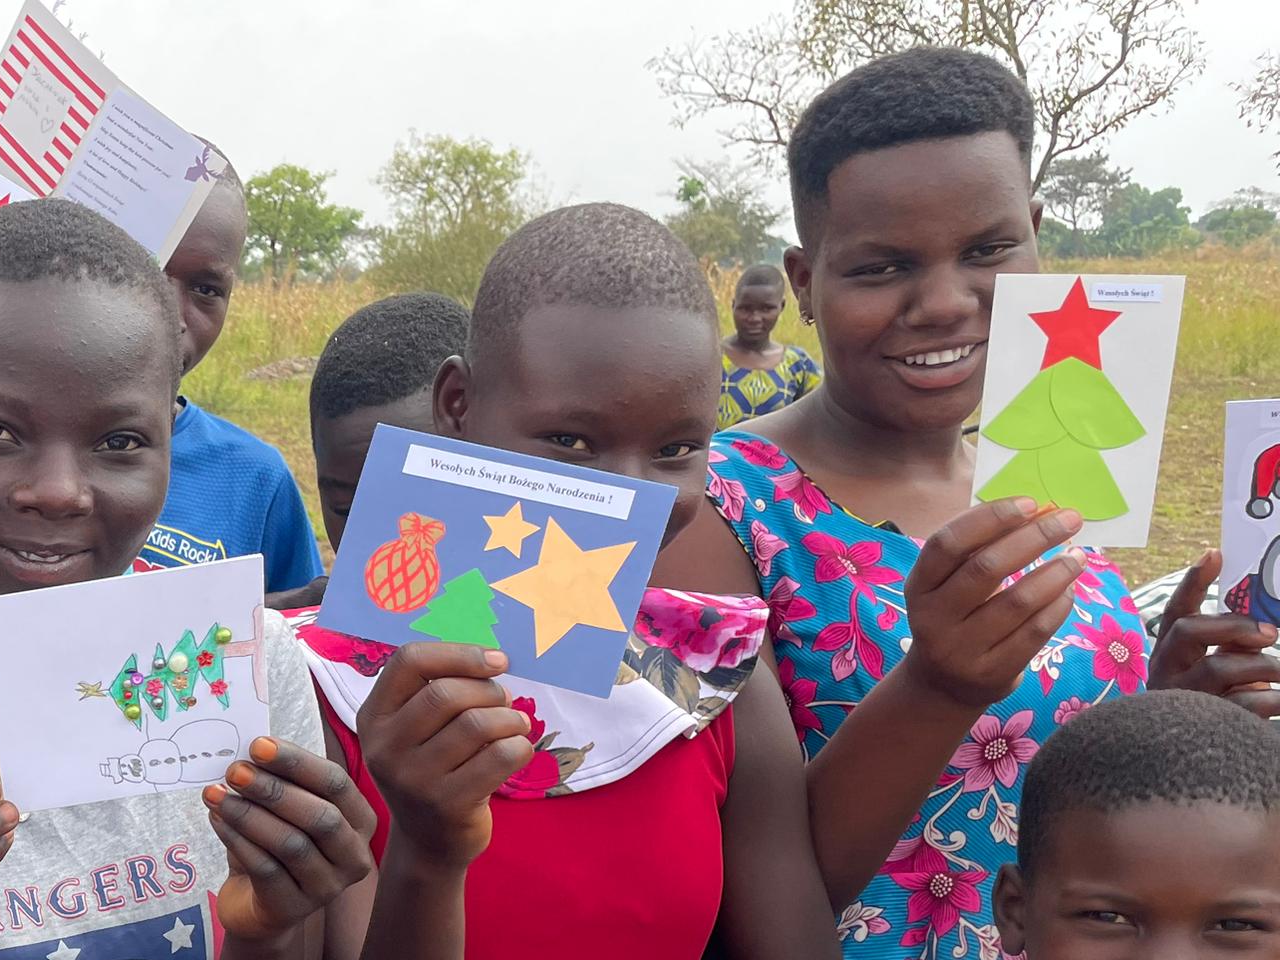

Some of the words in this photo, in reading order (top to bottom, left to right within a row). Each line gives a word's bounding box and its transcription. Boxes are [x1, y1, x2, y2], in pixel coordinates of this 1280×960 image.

[430, 458, 476, 477] Wesołych
[478, 467, 507, 485] Świąt
[509, 475, 544, 492] Bożego
[547, 482, 606, 504] Narodzenia
[147, 529, 176, 552] Kids
[178, 538, 218, 564] Rock!
